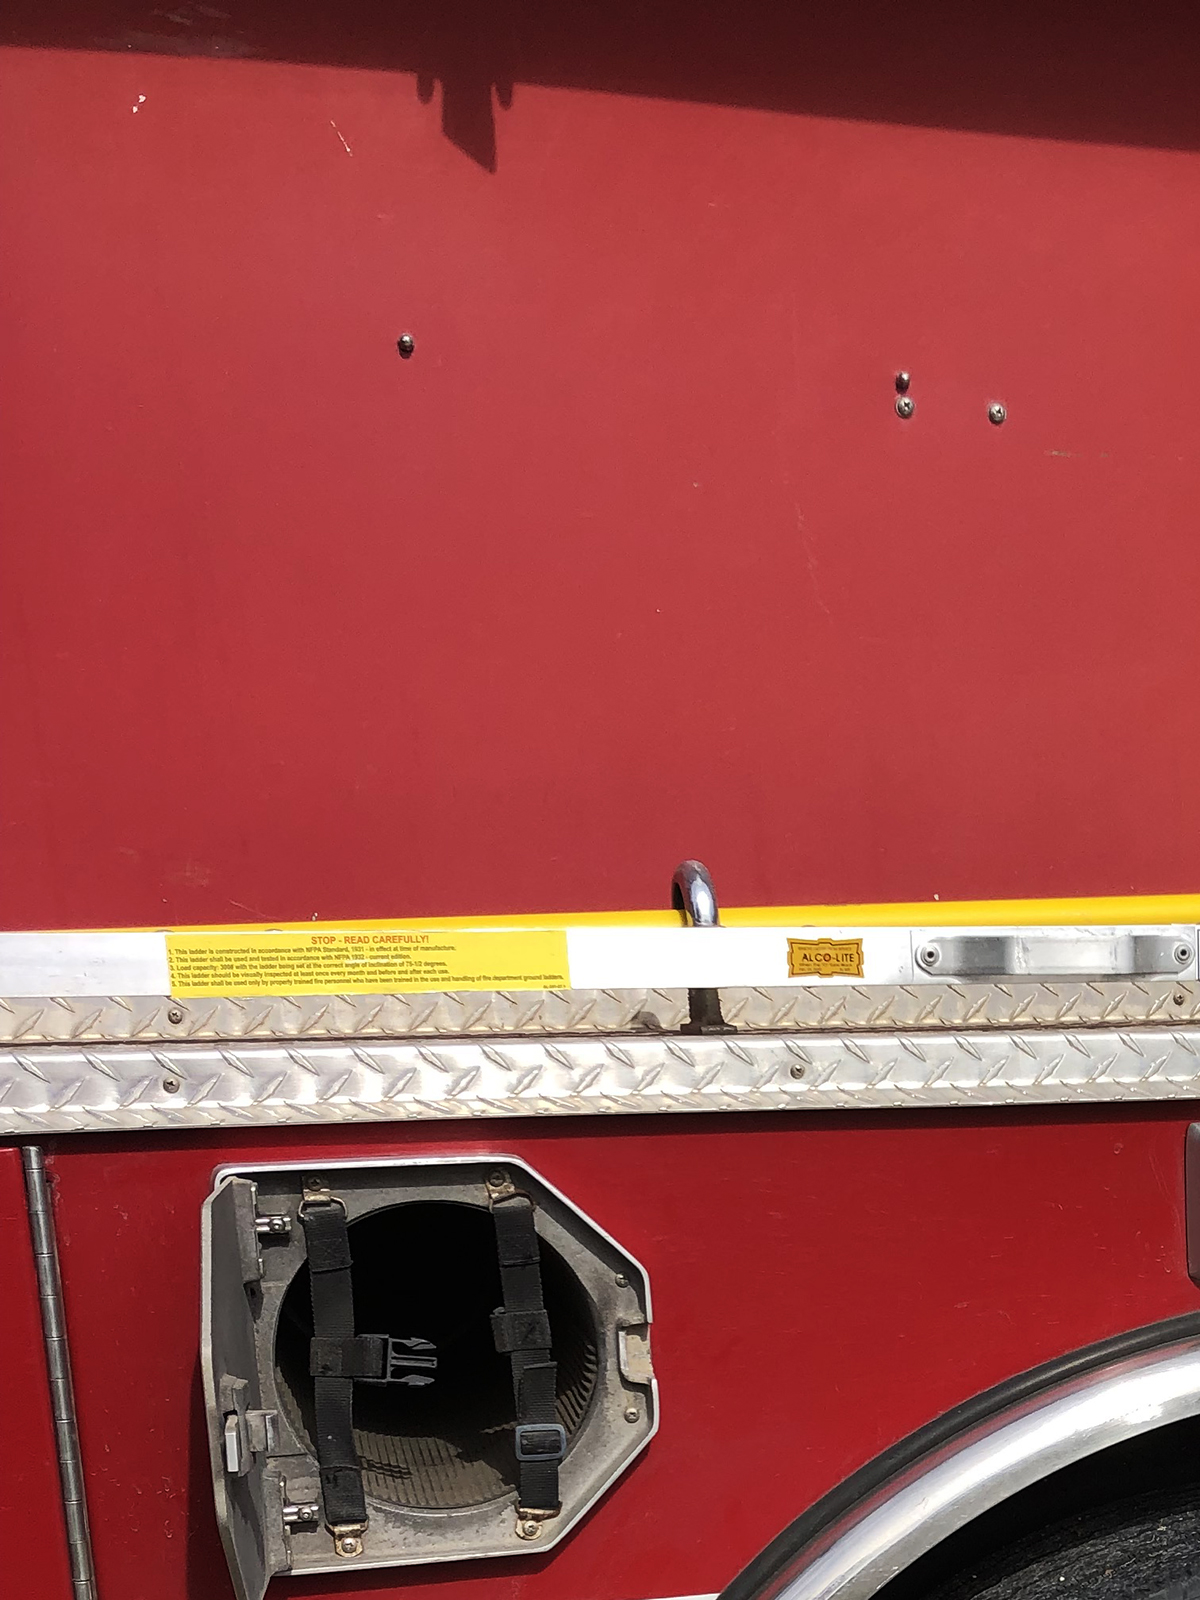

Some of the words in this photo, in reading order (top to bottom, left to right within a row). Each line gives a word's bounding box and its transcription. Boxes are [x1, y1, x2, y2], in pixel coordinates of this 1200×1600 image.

[311, 936, 336, 944] STOP
[343, 936, 370, 944] READ
[372, 935, 429, 944] CAREFULLY!
[802, 953, 854, 962] ALCO-LITE
